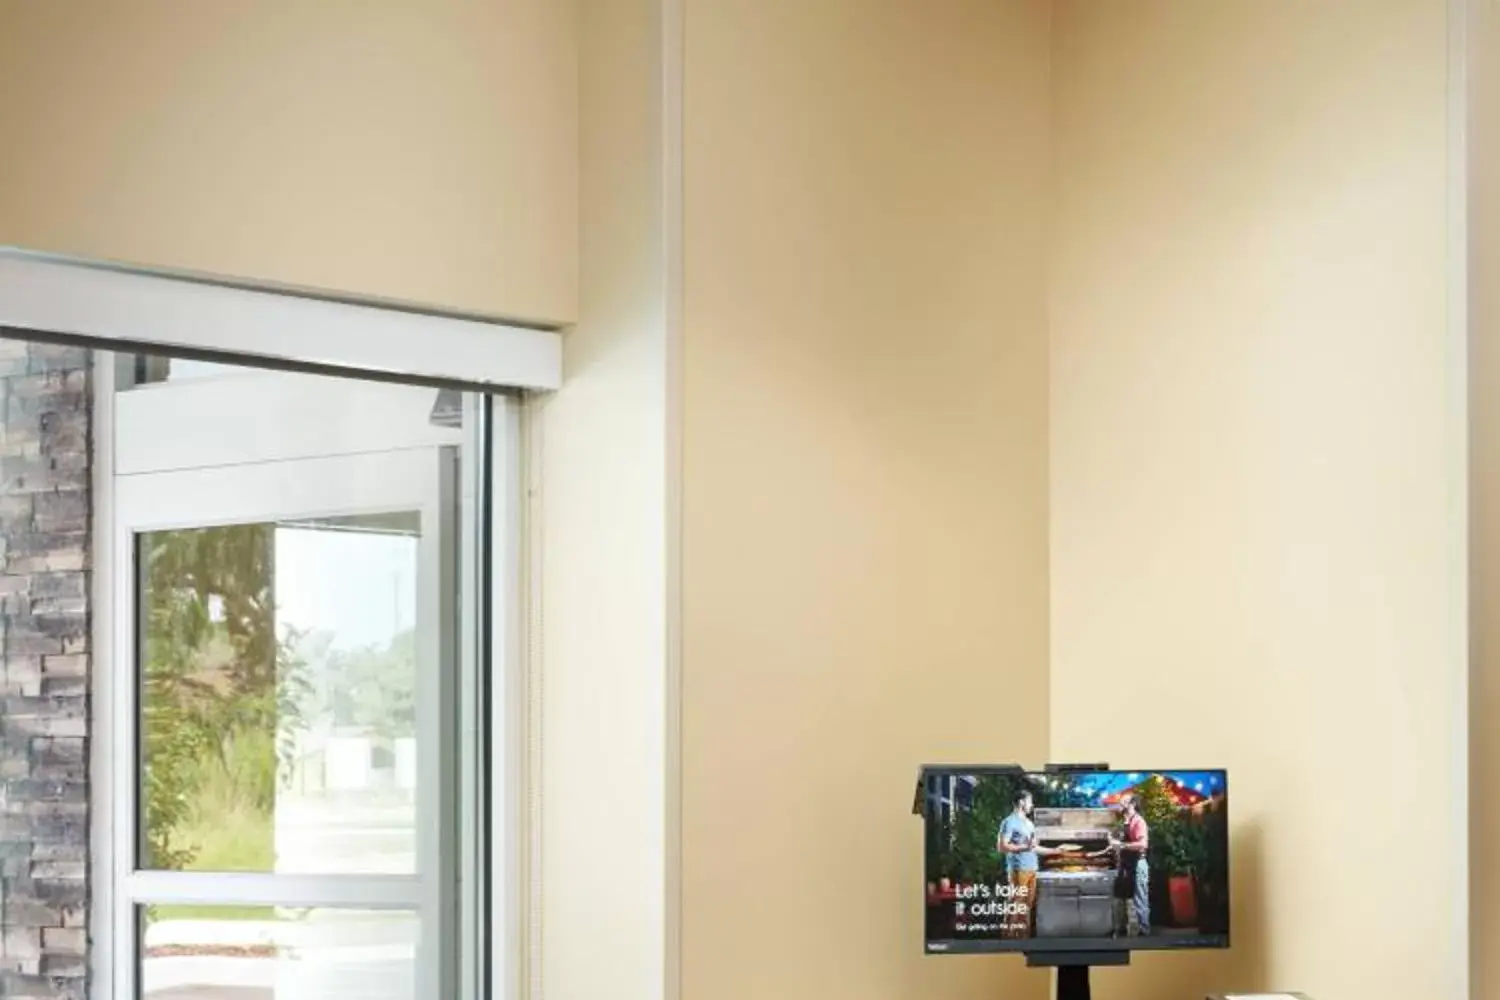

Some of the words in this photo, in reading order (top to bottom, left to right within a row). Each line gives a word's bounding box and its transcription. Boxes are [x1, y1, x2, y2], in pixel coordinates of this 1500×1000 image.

[955, 883, 991, 899] Let's
[995, 882, 1029, 899] take
[955, 901, 965, 915] it
[971, 901, 1027, 916] outside
